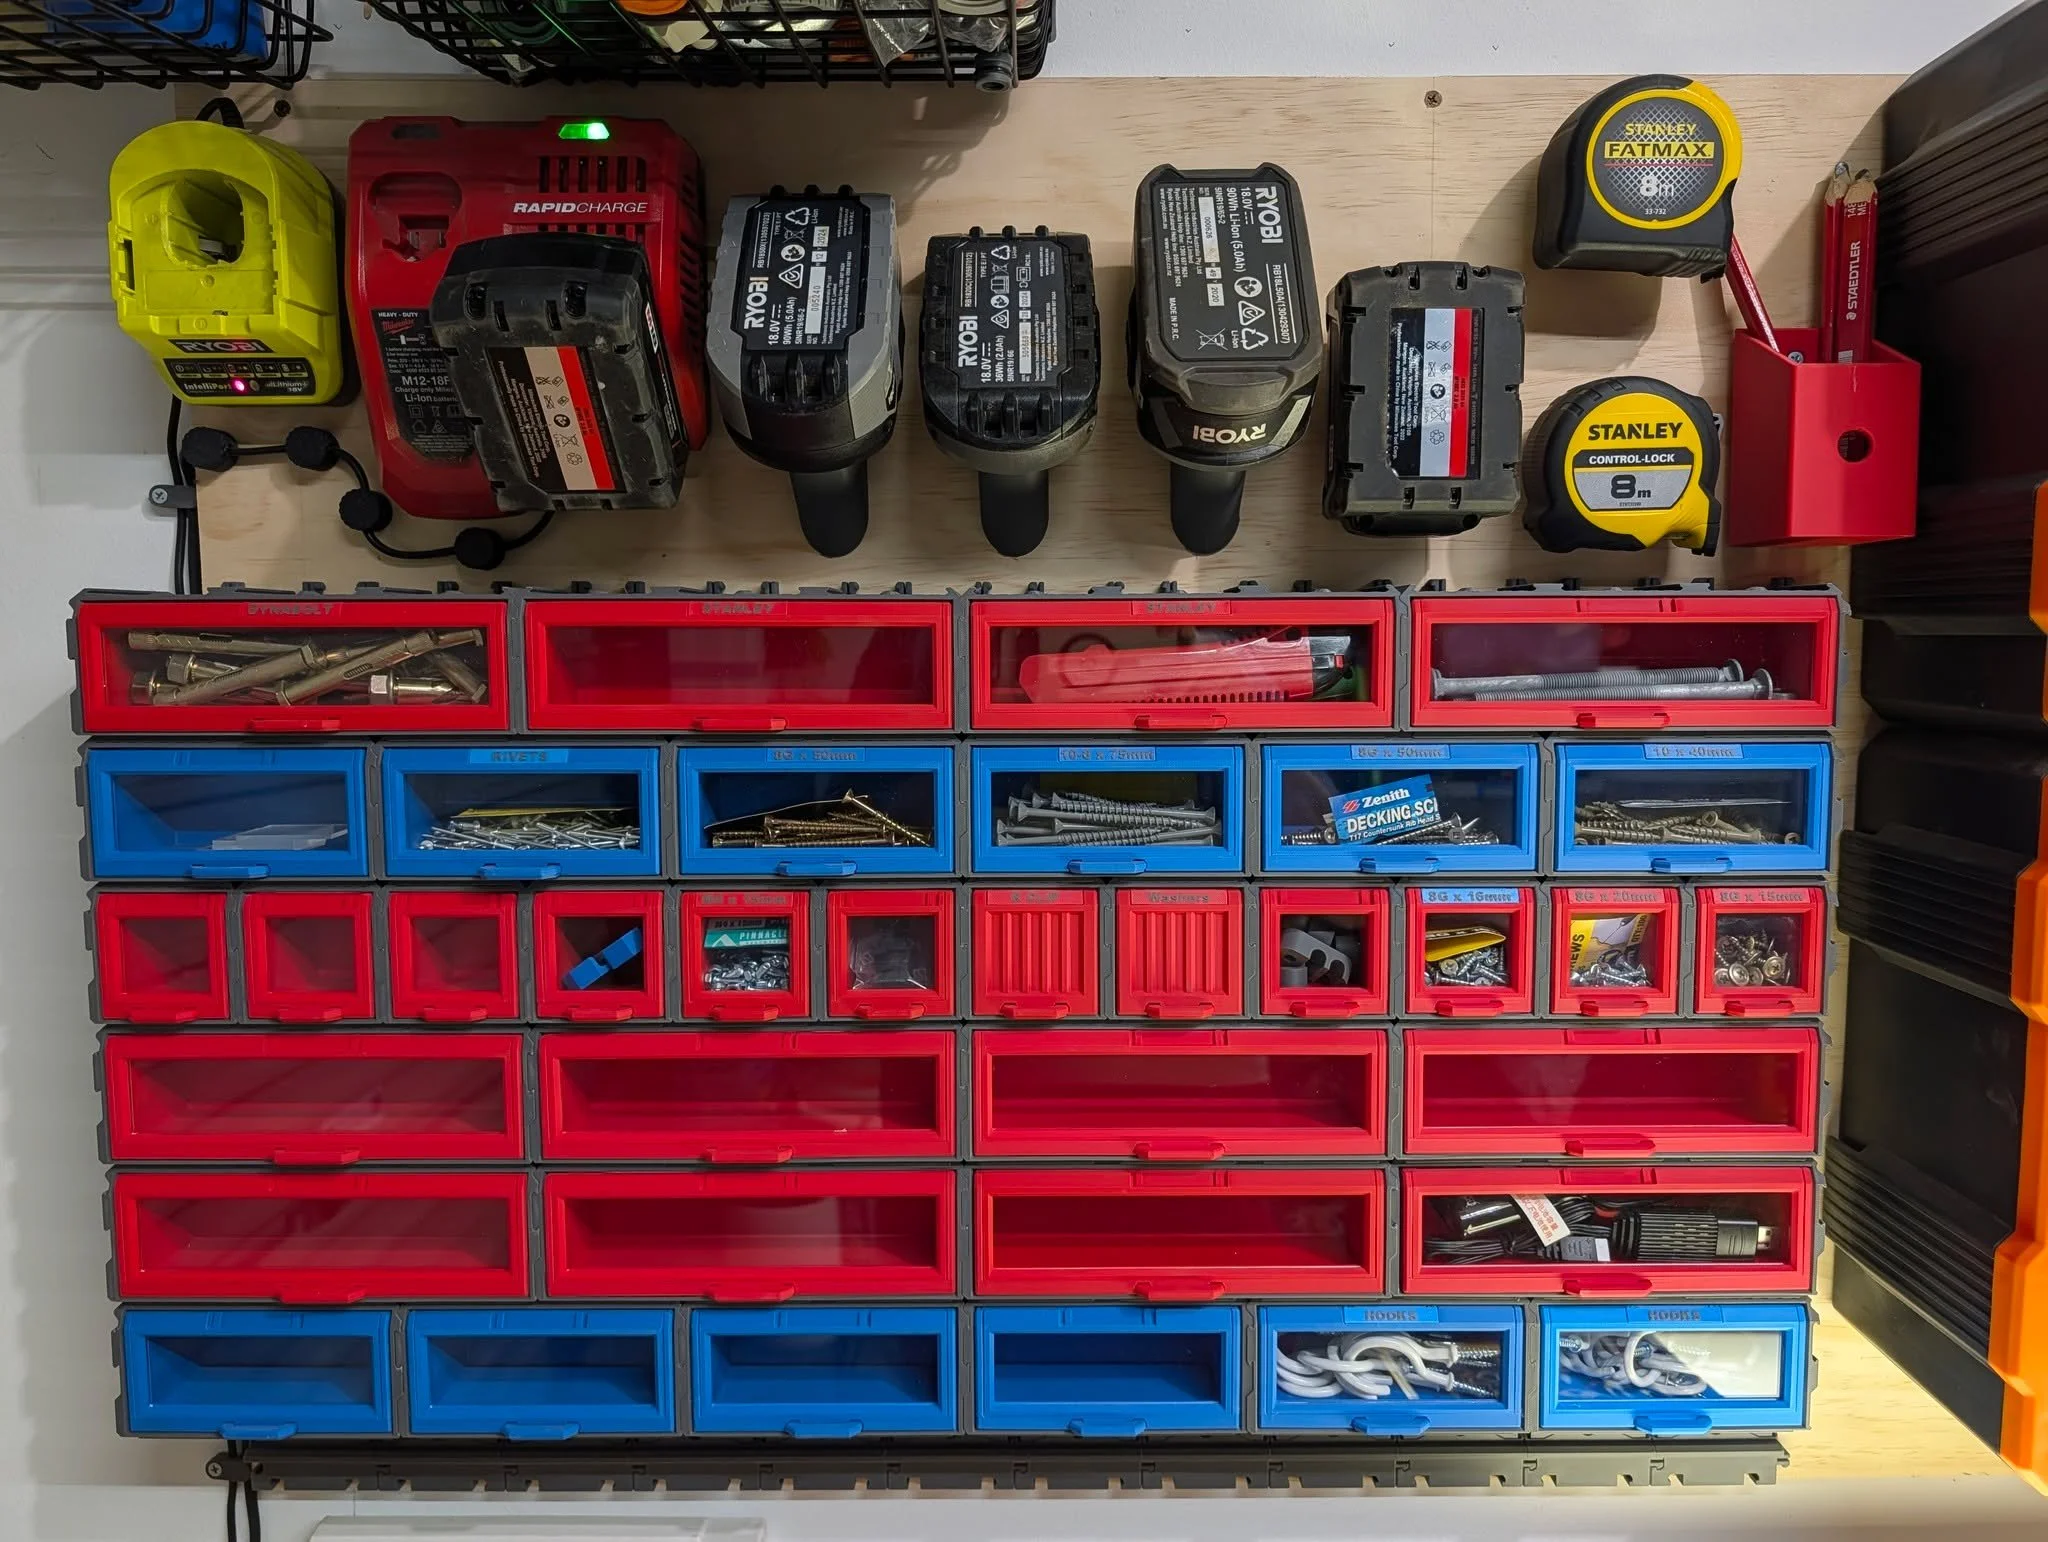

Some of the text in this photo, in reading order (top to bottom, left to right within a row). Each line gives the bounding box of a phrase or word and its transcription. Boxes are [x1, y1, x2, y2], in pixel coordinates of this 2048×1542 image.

[1625, 123, 1697, 136] STANLEY
[1608, 143, 1709, 157] FATMAX
[1639, 175, 1674, 197] 8m
[513, 202, 648, 213] RAPIDCHARGE
[1240, 186, 1252, 209] 18.0V
[1253, 186, 1283, 243] RYOBI
[1225, 187, 1246, 272] 90Wh Li-Ion (5.0Ah)
[1848, 241, 1861, 310] STAEDTLER
[743, 276, 769, 329] RYOBI
[1210, 287, 1219, 302] 2020
[783, 296, 797, 344] 90Wh (5.0Ah)
[767, 320, 780, 345] 18.0V
[957, 315, 978, 367] RYOBI
[176, 342, 266, 351] RYOBI
[995, 335, 1005, 360] (2.0Ah)
[981, 357, 991, 383] 18.0V
[1192, 423, 1267, 444] RYOBI
[1588, 422, 1683, 441] STANLEY
[1589, 453, 1675, 464] CONTROL-LOCK
[492, 751, 547, 761] RIVETS
[1362, 788, 1410, 808] Zenith
[1347, 806, 1412, 833] DECKING
[1350, 832, 1362, 841] T17
[1363, 822, 1405, 838] Countersunk
[1428, 891, 1448, 901] 8G
[740, 930, 787, 940] PINNACL
